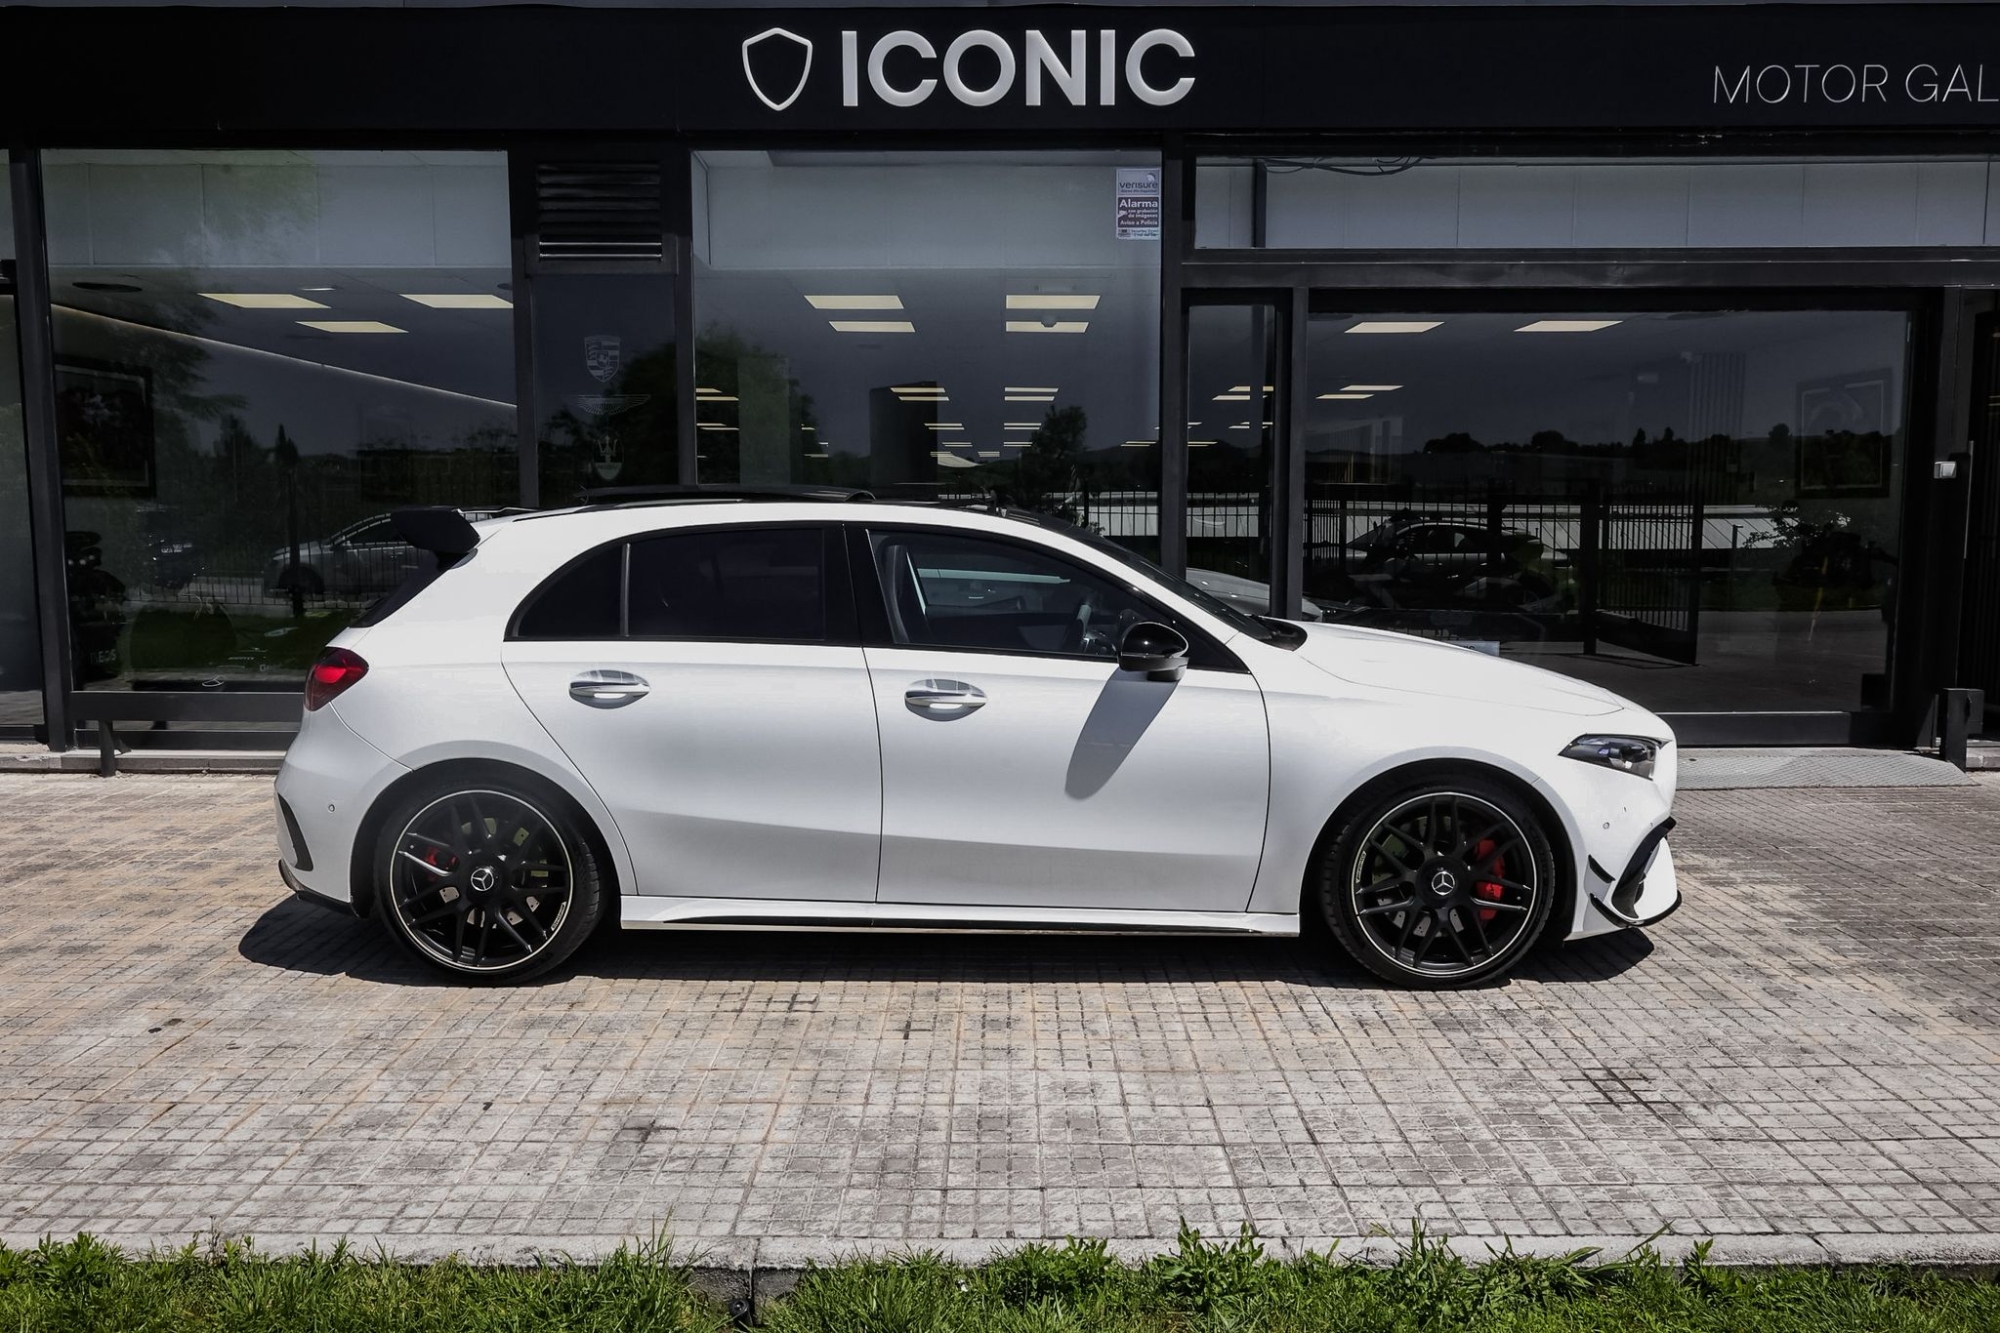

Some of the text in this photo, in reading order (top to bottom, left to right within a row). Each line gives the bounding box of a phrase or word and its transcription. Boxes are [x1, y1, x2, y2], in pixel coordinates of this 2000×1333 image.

[841, 28, 1196, 107] ICONIC
[1713, 63, 2000, 104] MOTOR GAL
[1119, 181, 1158, 189] verisure
[1119, 198, 1158, 208] Alarma
